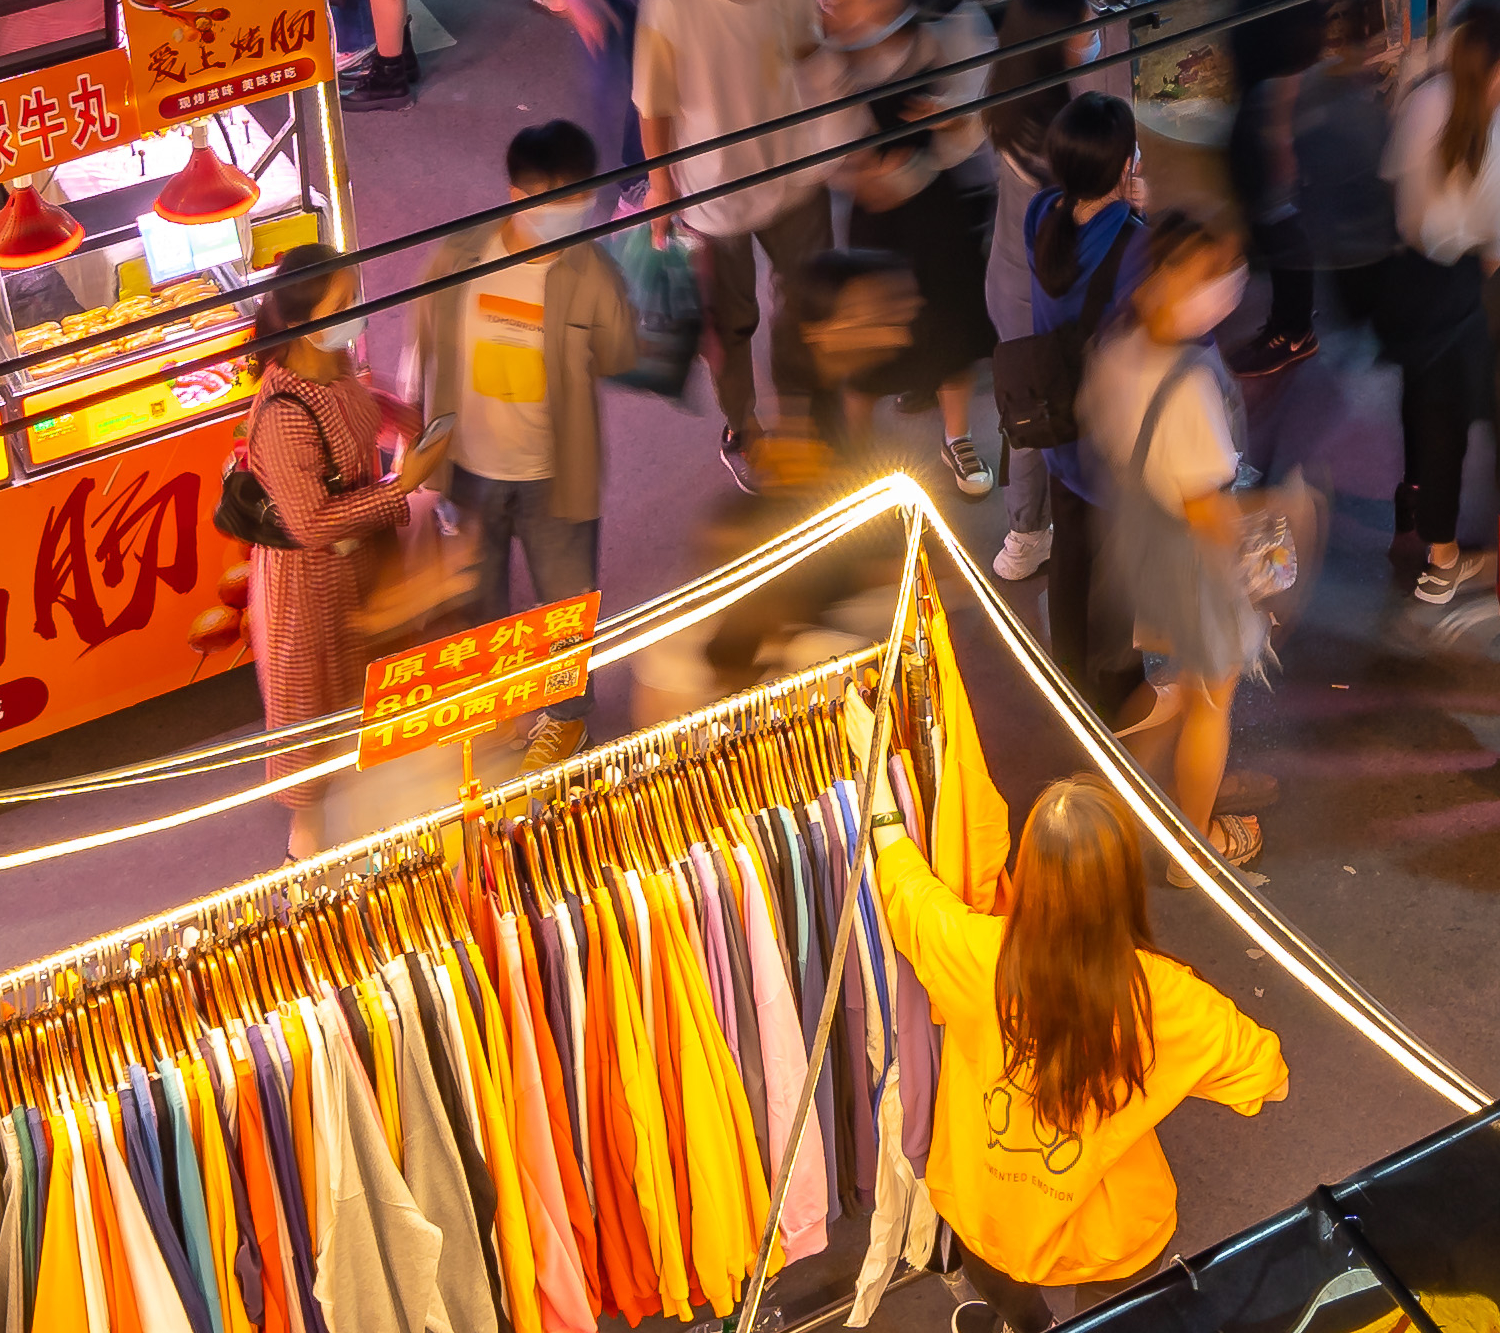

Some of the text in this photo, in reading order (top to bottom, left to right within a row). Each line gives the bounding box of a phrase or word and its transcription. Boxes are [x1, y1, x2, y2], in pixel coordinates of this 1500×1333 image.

[177, 66, 298, 110] 现烤滋味 美味好吃
[378, 600, 588, 691] 原单外贸
[373, 679, 540, 748] 150两件
